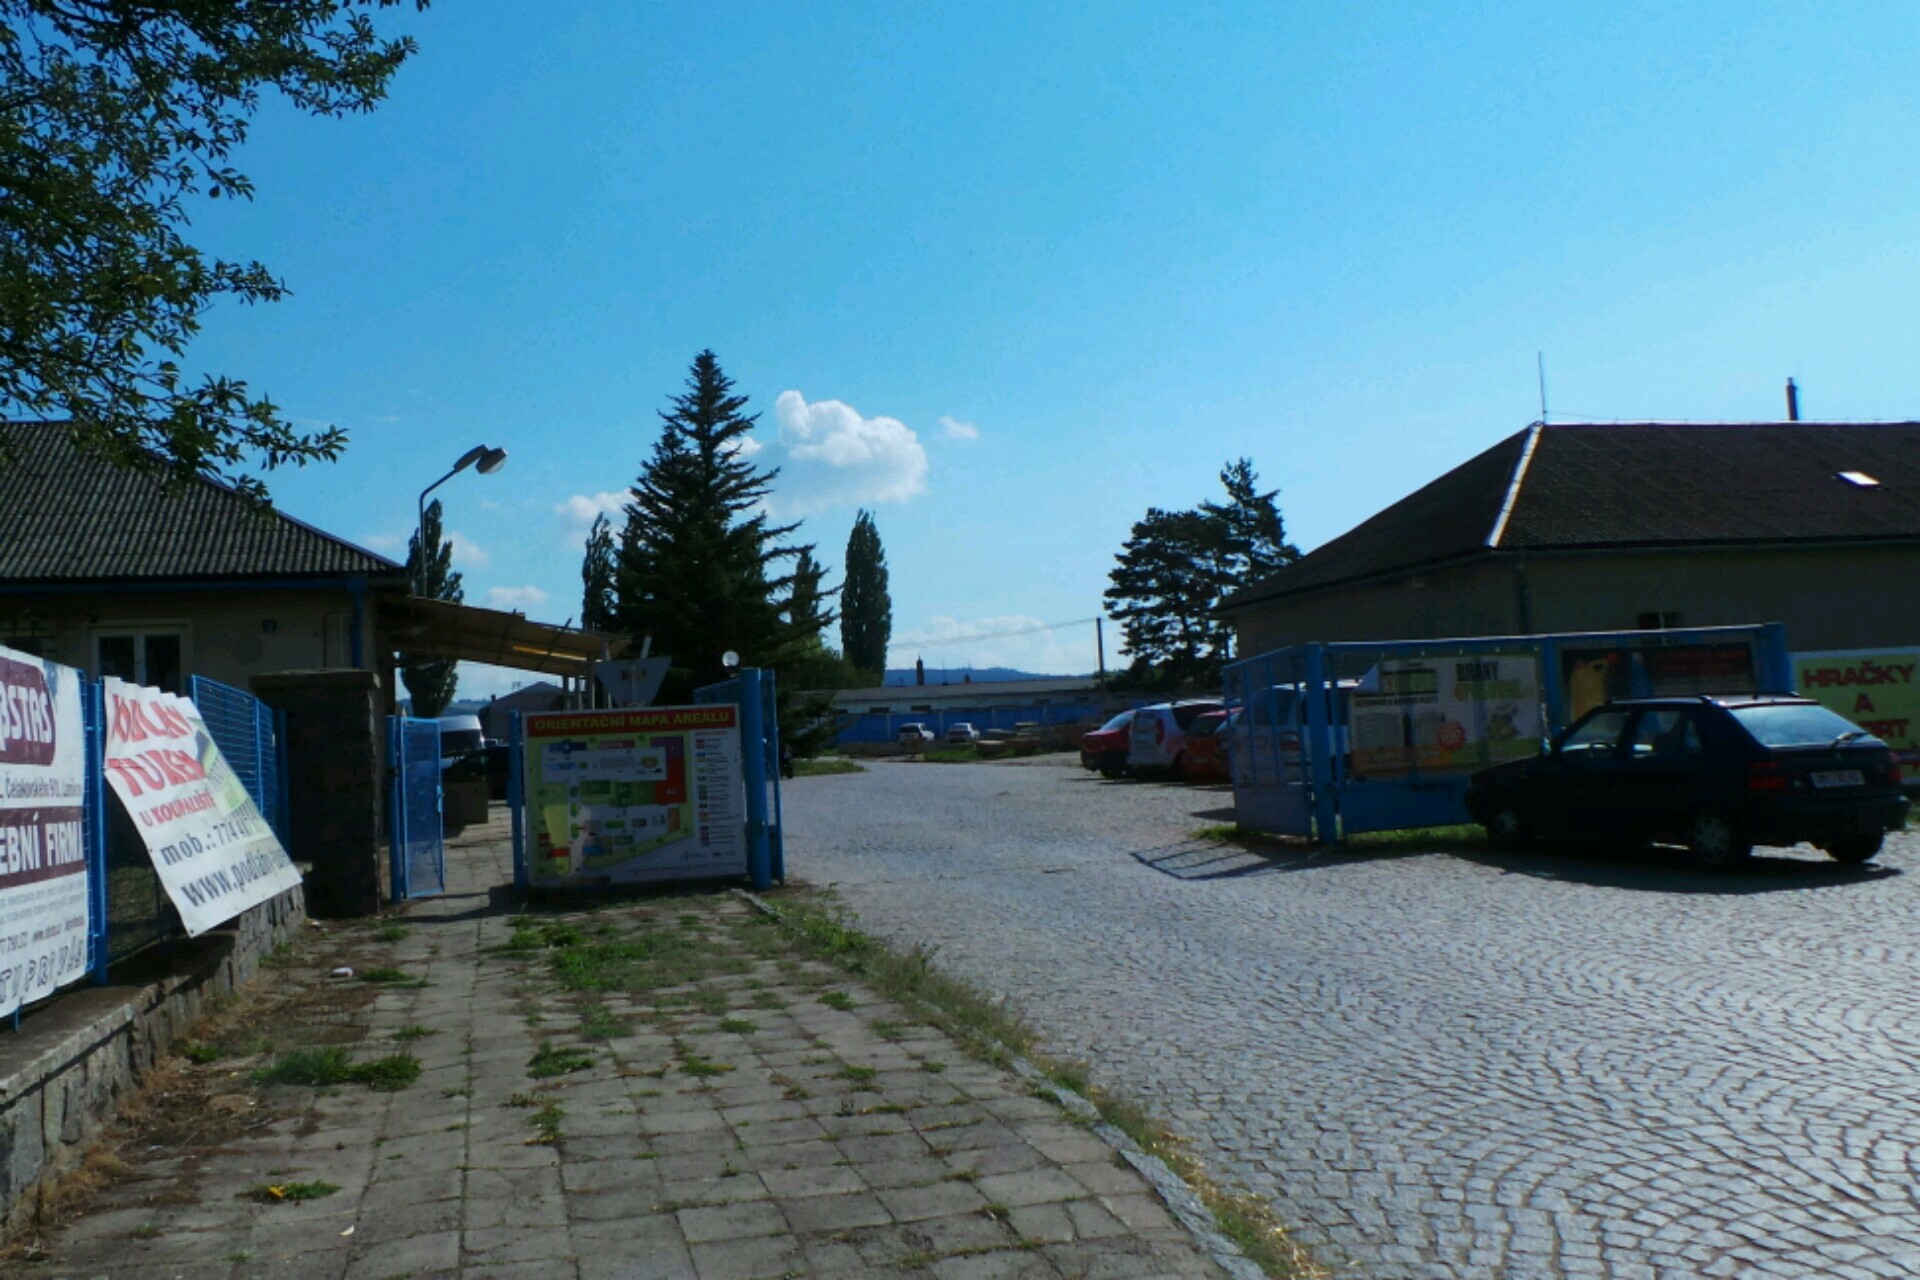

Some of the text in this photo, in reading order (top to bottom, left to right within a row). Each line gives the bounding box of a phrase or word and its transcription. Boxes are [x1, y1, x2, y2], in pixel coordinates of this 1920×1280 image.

[1803, 659, 1916, 689] HRAČKY
[1854, 693, 1875, 712] A
[535, 714, 625, 731] ORIENTAČNÍ
[629, 713, 669, 727] MAPA
[138, 811, 154, 828] U
